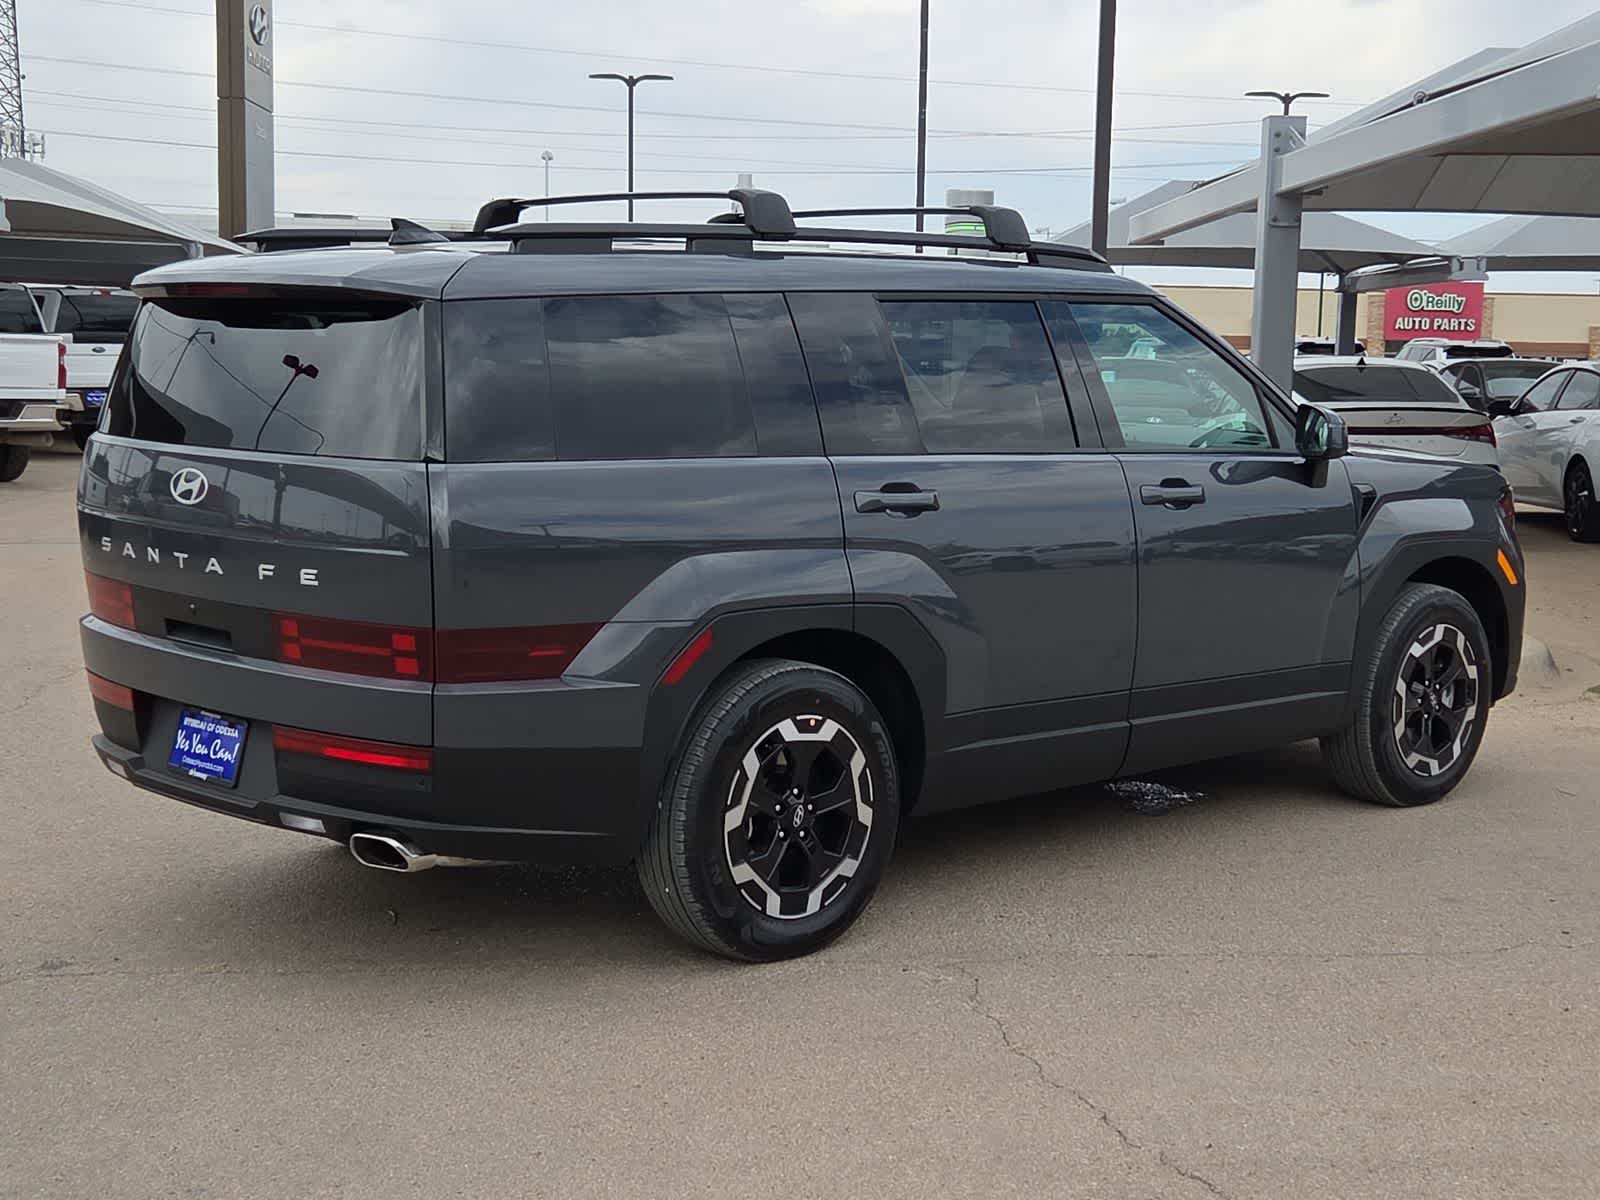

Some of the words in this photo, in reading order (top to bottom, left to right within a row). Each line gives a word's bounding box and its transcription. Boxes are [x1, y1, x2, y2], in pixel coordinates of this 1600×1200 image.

[1407, 290, 1466, 313] O'Reilly
[1395, 317, 1430, 330] AUTO
[1433, 318, 1476, 331] PARTS
[101, 536, 224, 575] SANTA
[258, 563, 319, 586] FE
[175, 729, 190, 752] Yes
[191, 733, 208, 755] You
[210, 739, 240, 764] Can!
